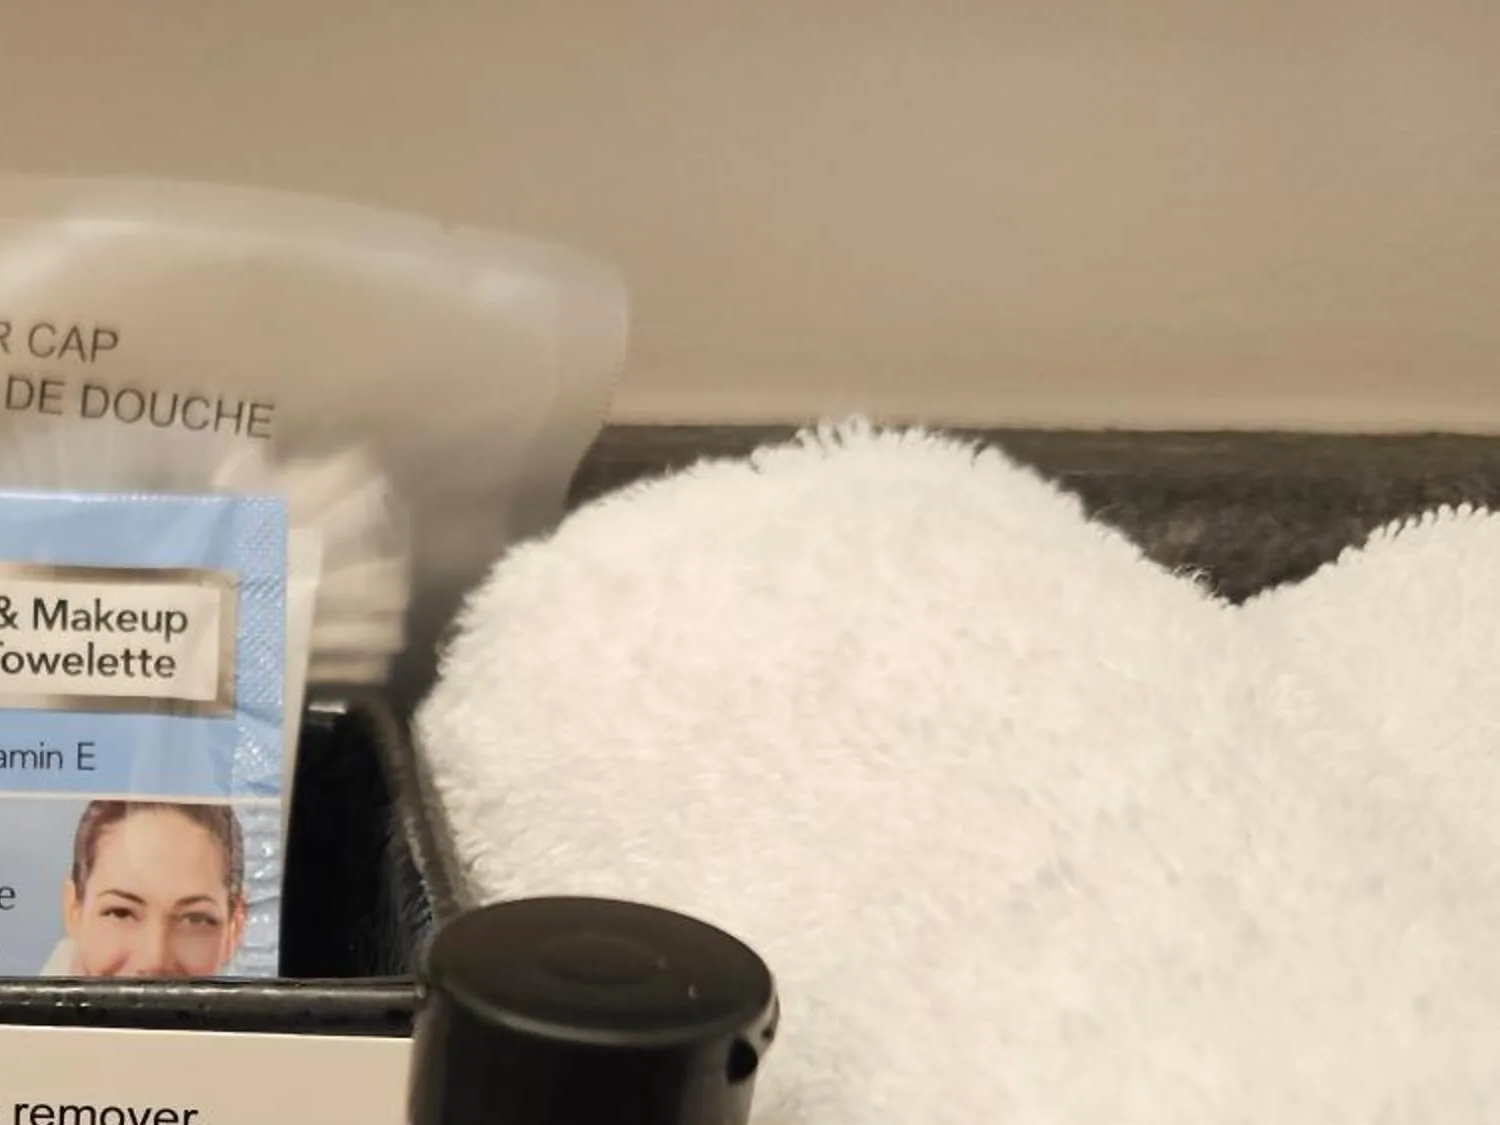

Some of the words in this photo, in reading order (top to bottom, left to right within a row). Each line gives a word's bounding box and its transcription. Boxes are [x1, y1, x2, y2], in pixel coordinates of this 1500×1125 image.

[27, 323, 119, 364] CAP
[5, 375, 64, 414] DE
[80, 383, 275, 439] DOUCHE
[33, 598, 189, 640] Makeup
[76, 742, 96, 772] E
